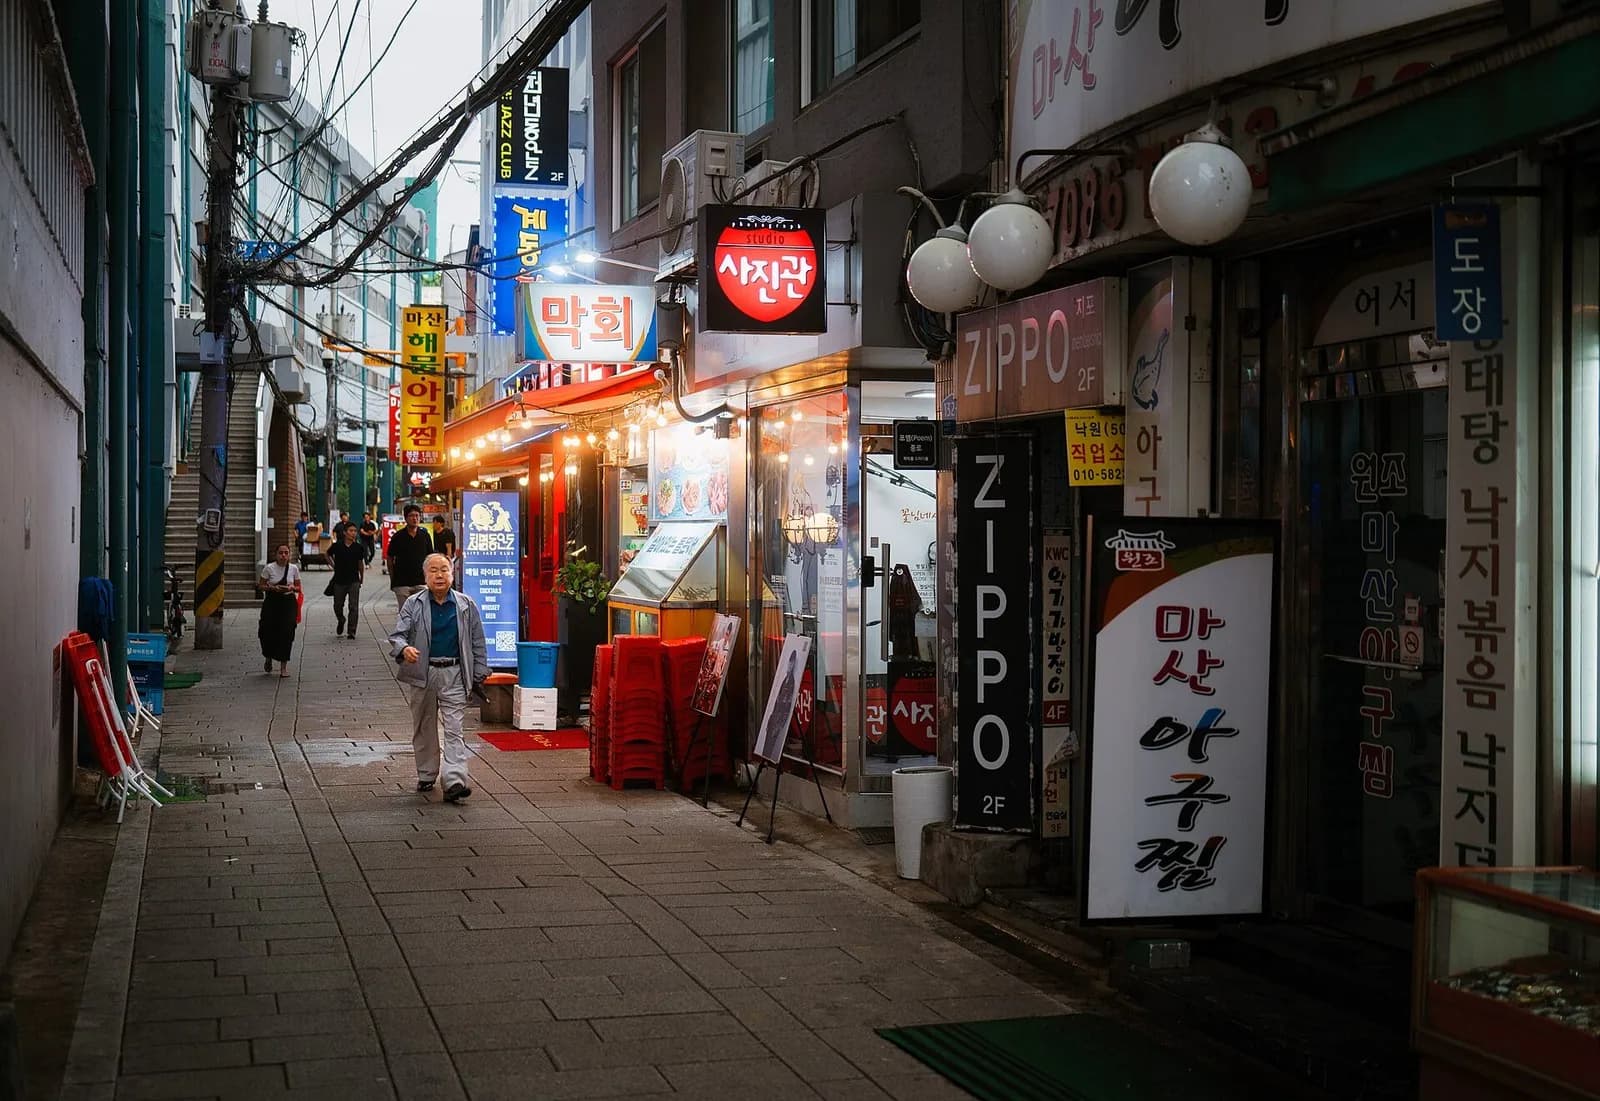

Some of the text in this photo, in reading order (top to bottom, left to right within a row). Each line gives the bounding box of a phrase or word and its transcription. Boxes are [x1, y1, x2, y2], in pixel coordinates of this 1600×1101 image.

[1032, 0, 1104, 120] 마산
[501, 104, 512, 138] JAZZ
[500, 142, 512, 179] CLUB
[550, 172, 564, 182] 2F
[746, 232, 785, 245] studio
[719, 253, 812, 303] 사진관
[1355, 278, 1417, 326] 어서
[1450, 238, 1487, 335] 도장
[406, 312, 443, 327] 마산
[541, 295, 633, 350] 막회
[964, 309, 1070, 396] ZIPPO
[1078, 366, 1096, 391] 2F
[1461, 322, 1508, 464] 태탕
[1350, 451, 1408, 504] 원조
[480, 568, 500, 577] 라이브
[1045, 547, 1069, 561] KWC
[1120, 551, 1159, 569] 원조
[1359, 510, 1400, 623] 마산
[973, 454, 1010, 771] ZIPPO
[1455, 486, 1508, 712] 낙지볶음
[1046, 704, 1067, 720] 4F
[1136, 603, 1239, 891] 마산 아구찜
[982, 795, 1005, 815] 2F
